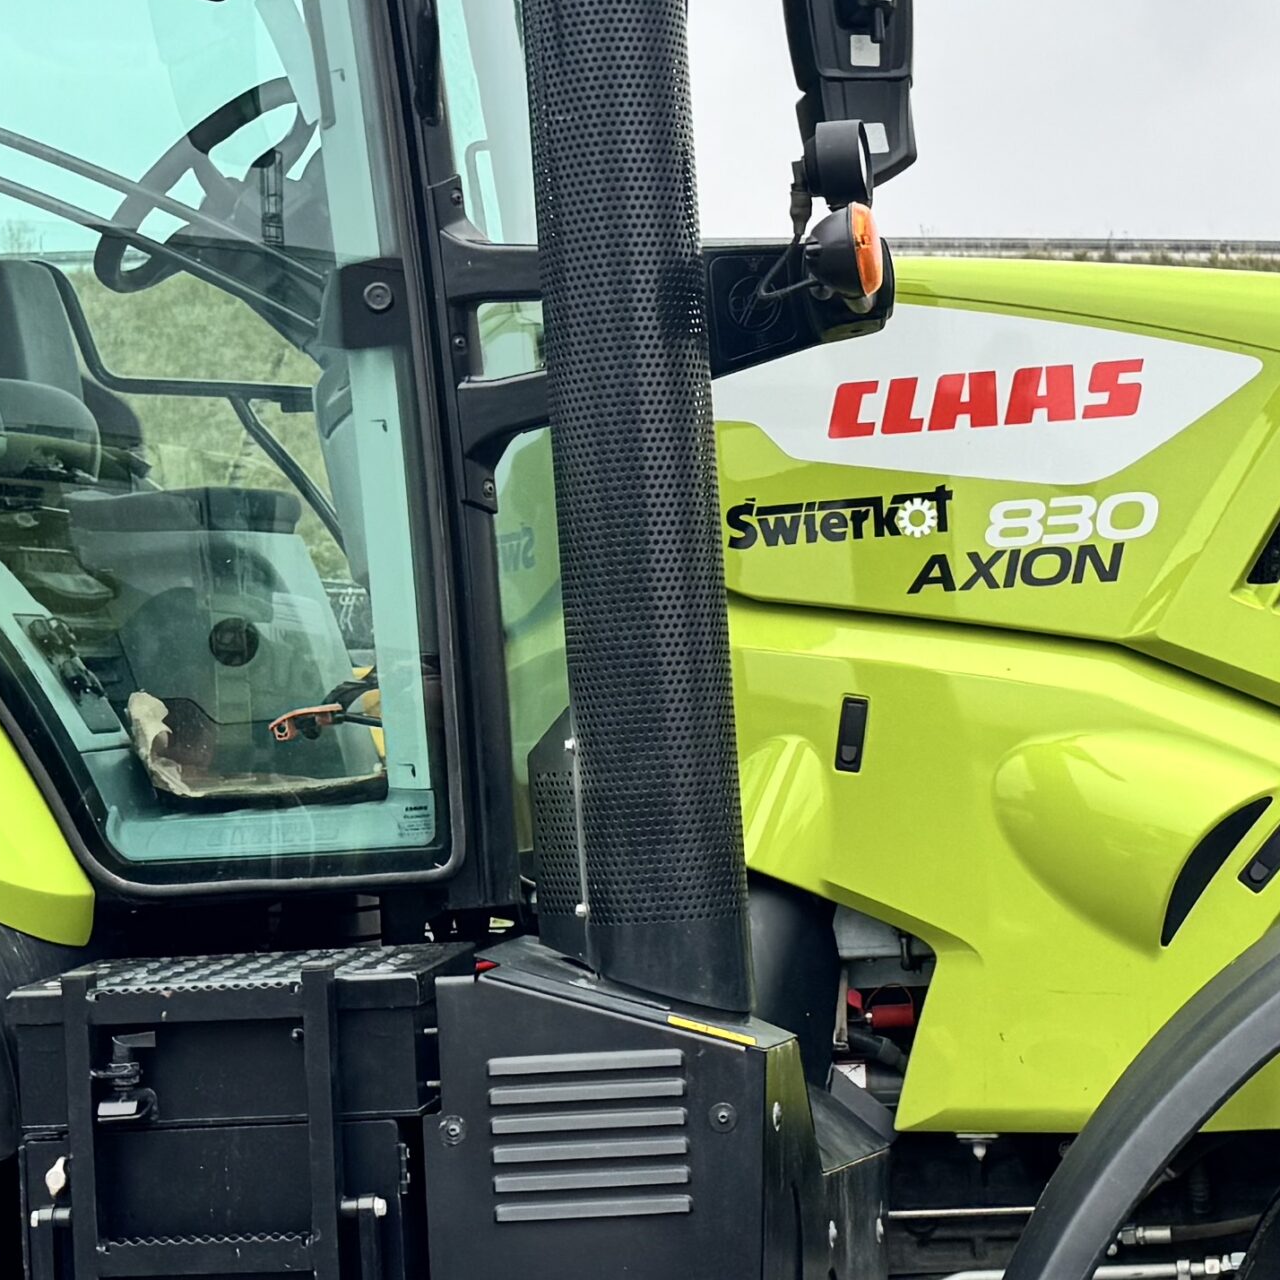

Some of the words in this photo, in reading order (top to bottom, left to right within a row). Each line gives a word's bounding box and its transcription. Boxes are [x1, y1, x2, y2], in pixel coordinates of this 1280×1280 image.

[828, 358, 1144, 439] CLAAS
[985, 491, 1159, 548] 830
[907, 541, 1125, 595] AXION
